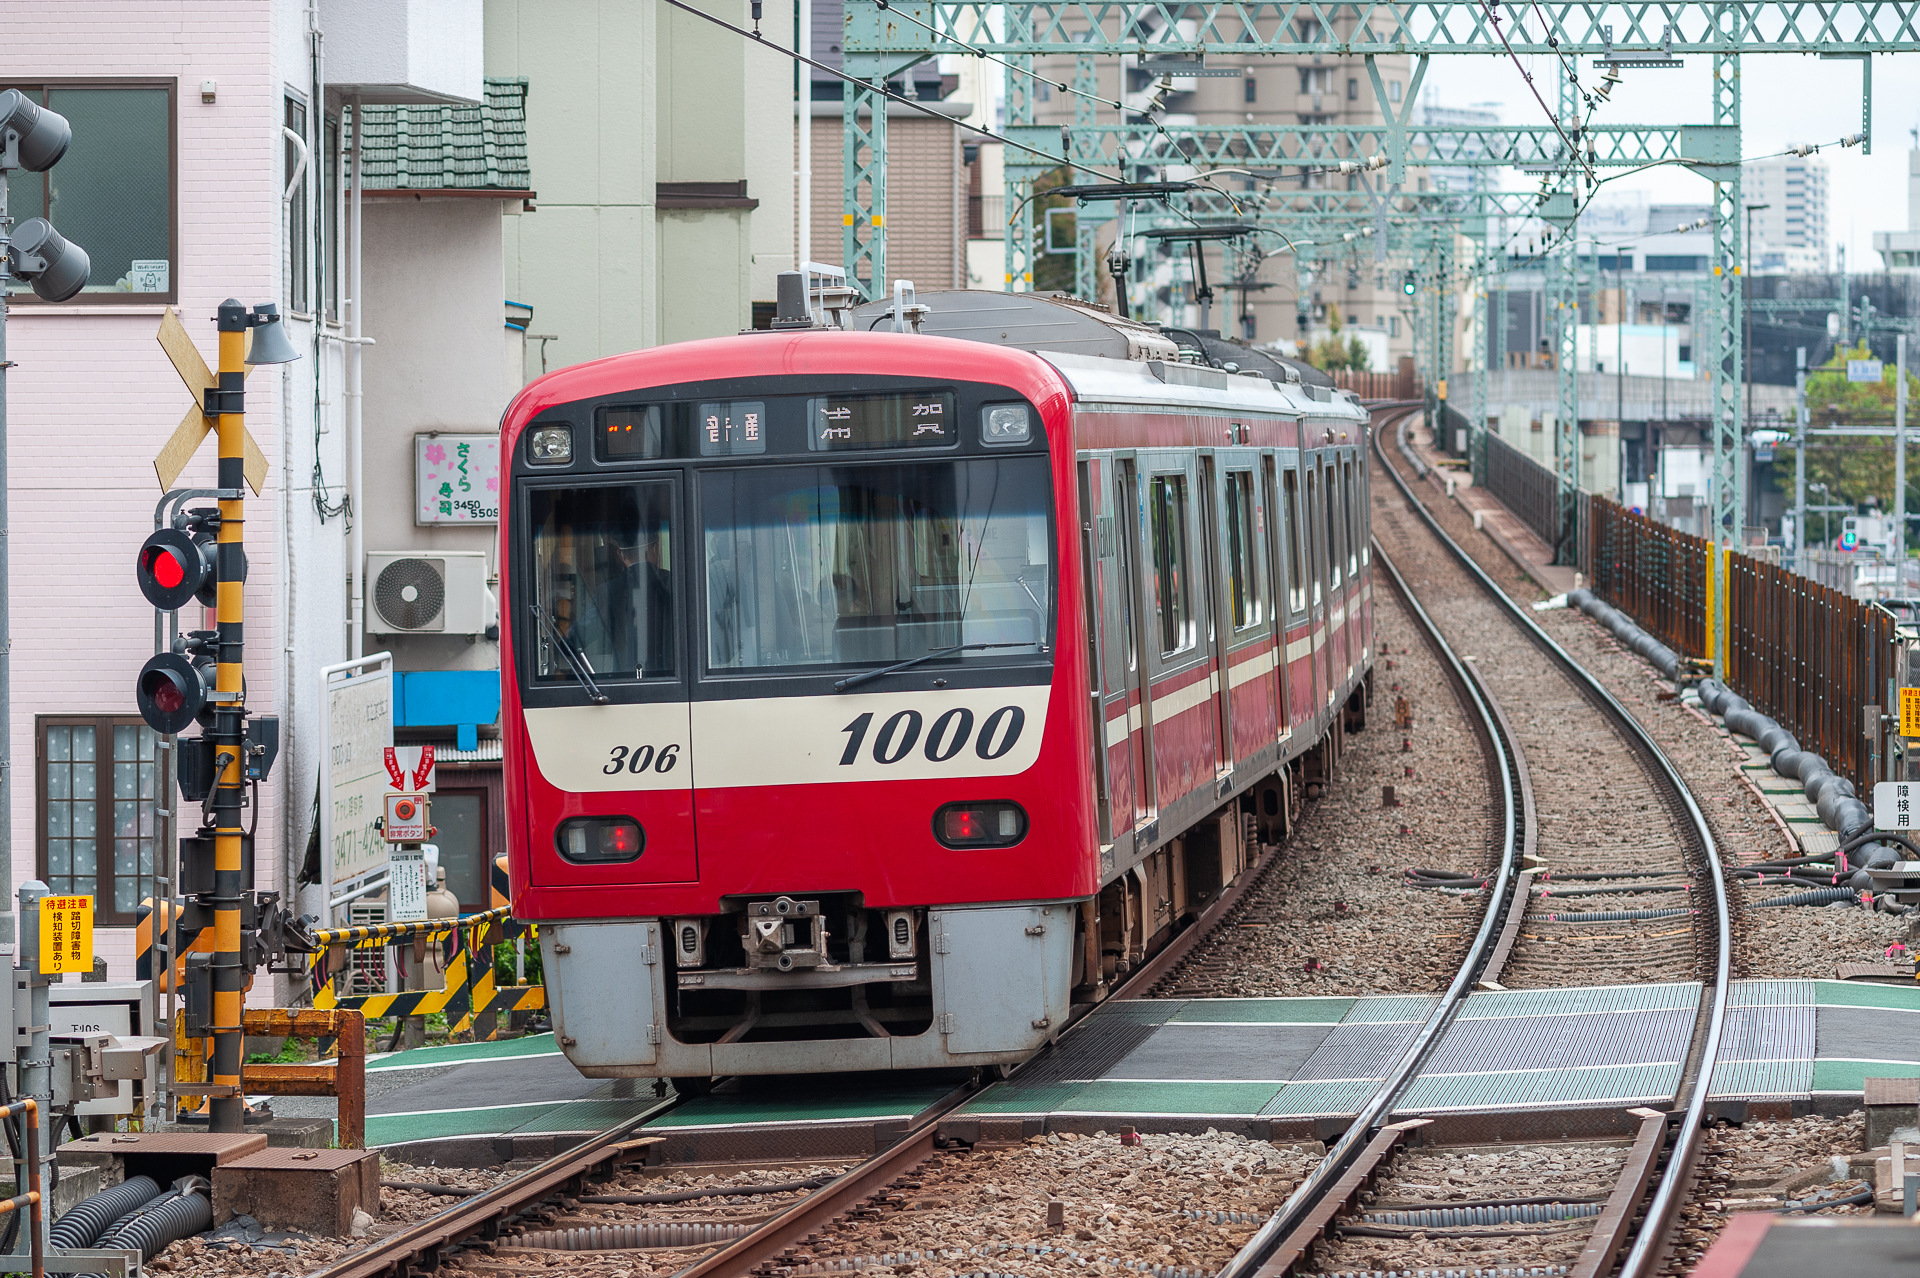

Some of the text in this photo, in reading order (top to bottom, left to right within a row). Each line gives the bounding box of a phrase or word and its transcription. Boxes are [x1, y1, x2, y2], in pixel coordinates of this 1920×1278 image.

[457, 442, 471, 492] さくら
[439, 482, 453, 516] 寿司
[454, 500, 480, 510] 3450
[839, 705, 1026, 767] 1000
[603, 744, 680, 775] 306
[1897, 785, 1909, 827] 障検用
[389, 829, 423, 838] 非常ボタン
[46, 898, 88, 910] 待避注意
[52, 911, 63, 971] 検知装置あり
[70, 911, 81, 961] 踏切障害物
